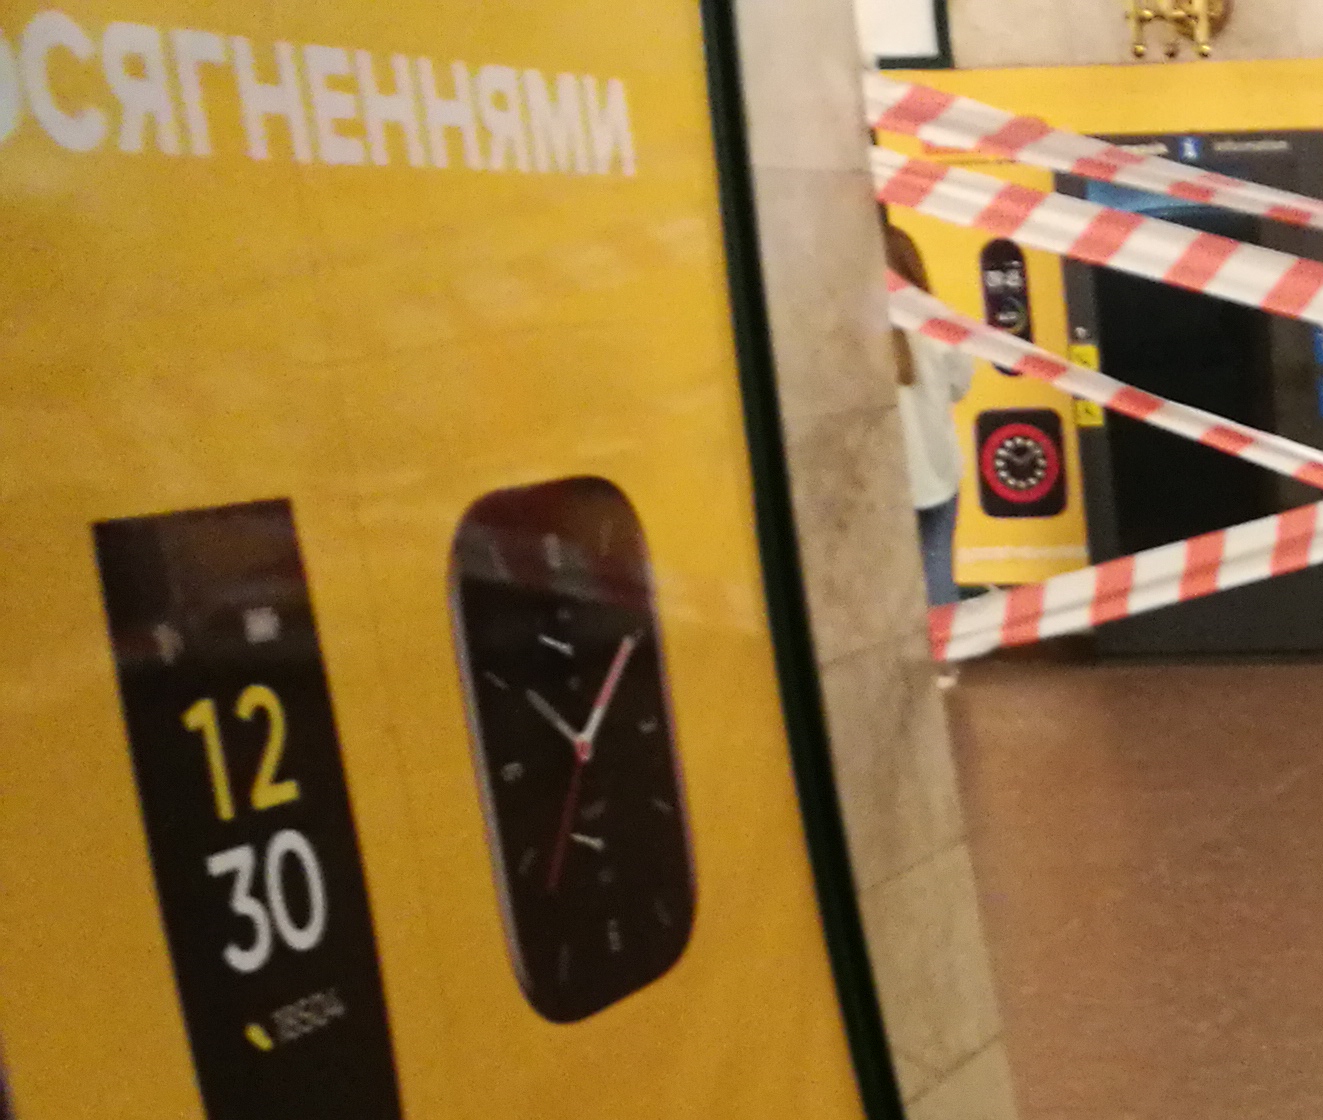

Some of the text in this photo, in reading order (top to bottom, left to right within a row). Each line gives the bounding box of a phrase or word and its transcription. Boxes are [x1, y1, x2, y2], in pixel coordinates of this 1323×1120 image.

[0, 10, 637, 177] СЯГНЕННЯМИ
[181, 684, 300, 821] 12
[206, 829, 328, 974] 30
